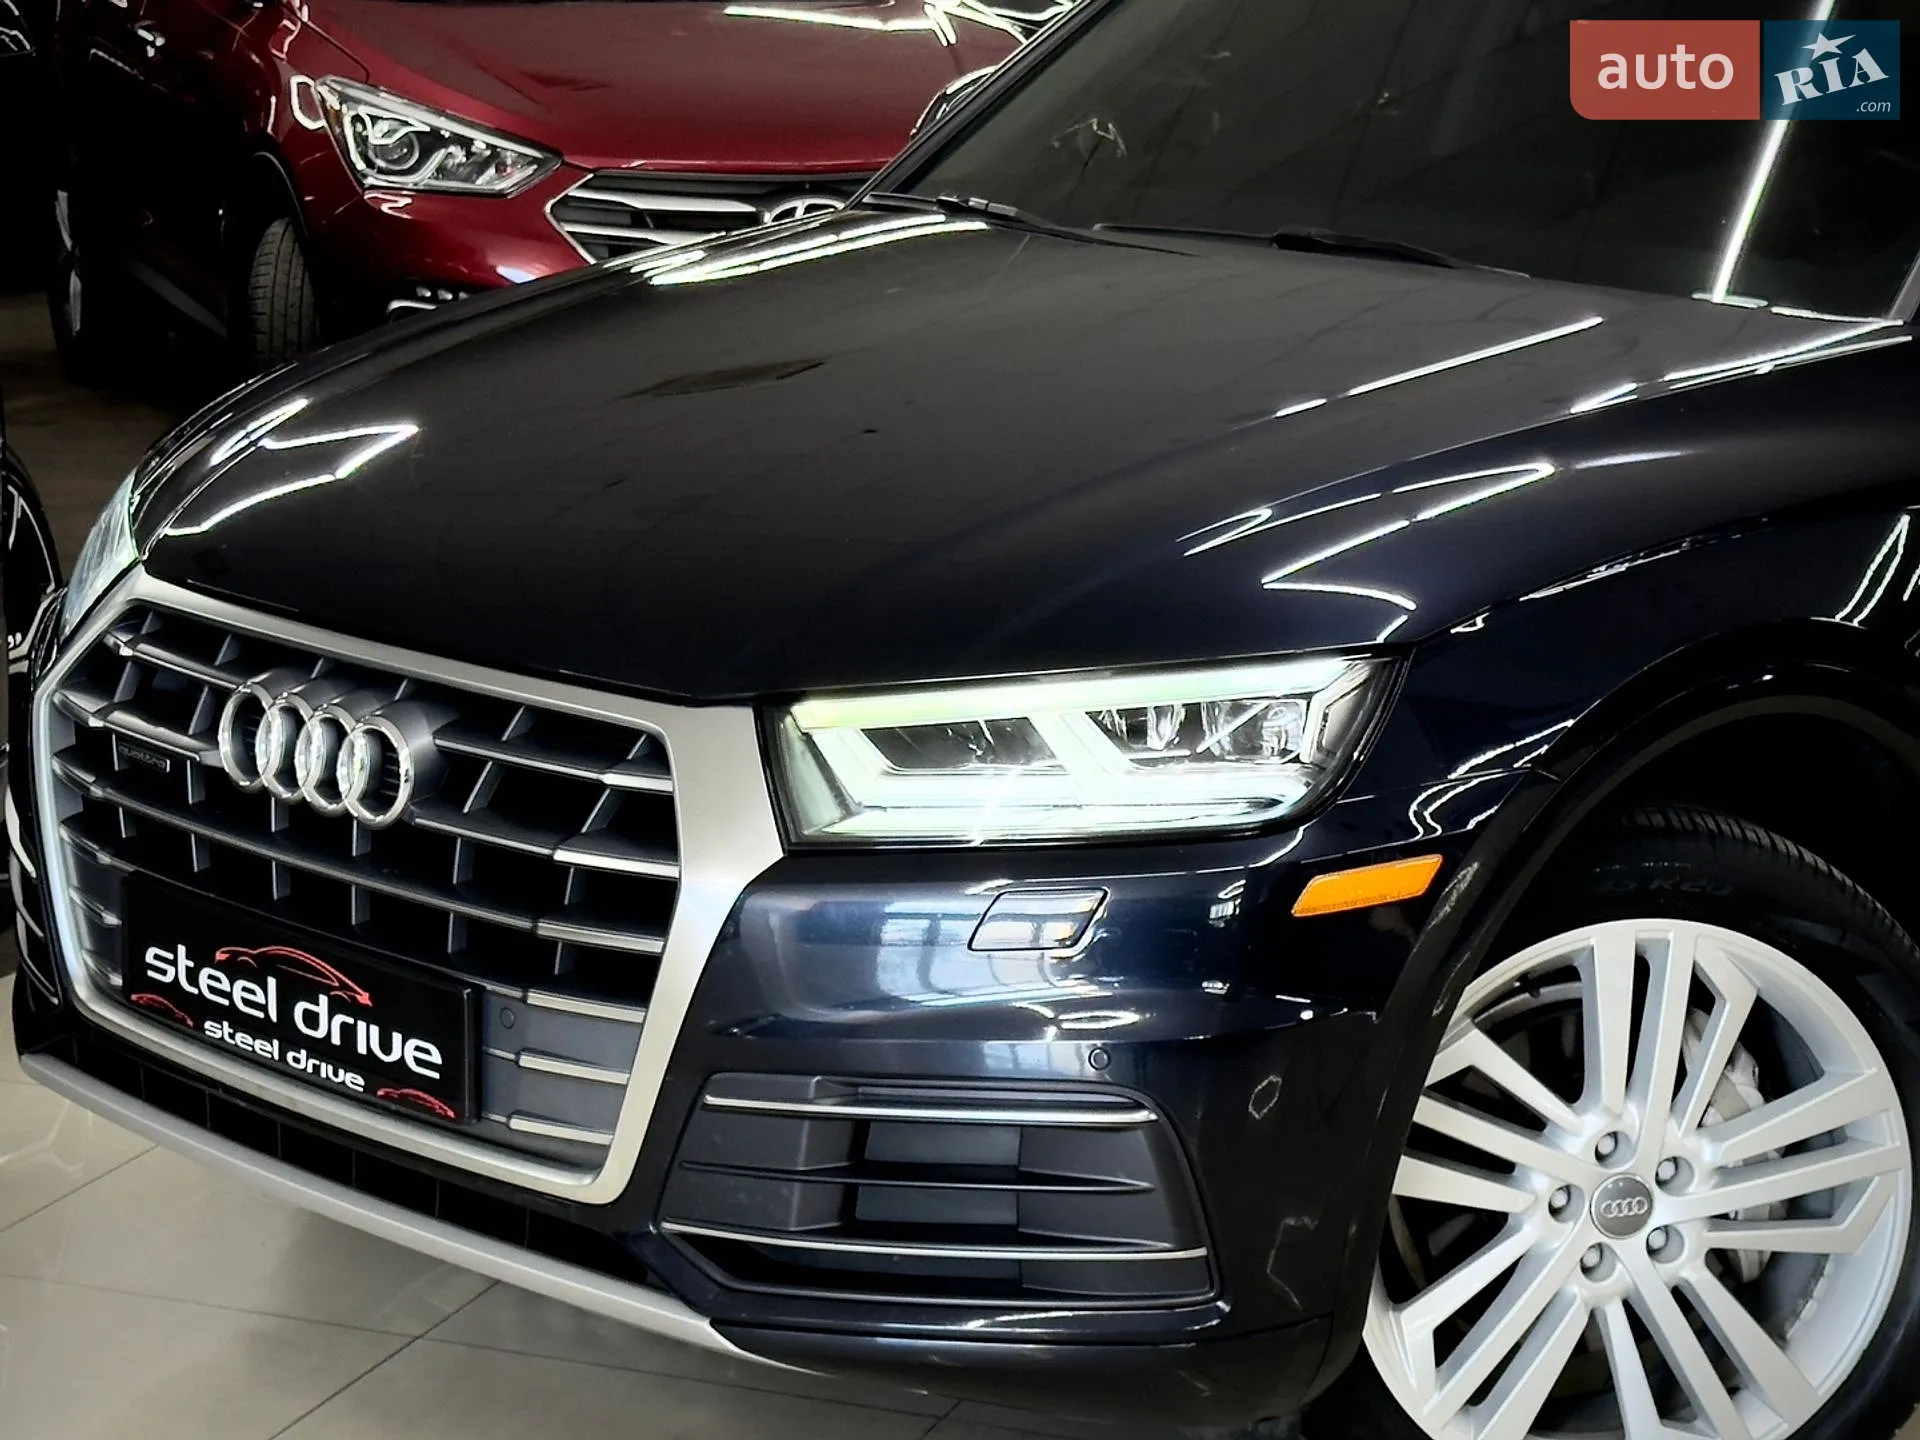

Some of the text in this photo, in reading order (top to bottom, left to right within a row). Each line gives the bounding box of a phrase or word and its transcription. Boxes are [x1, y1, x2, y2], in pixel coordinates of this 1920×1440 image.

[145, 943, 443, 1080] steel drive
[203, 1020, 366, 1093] steel drive
